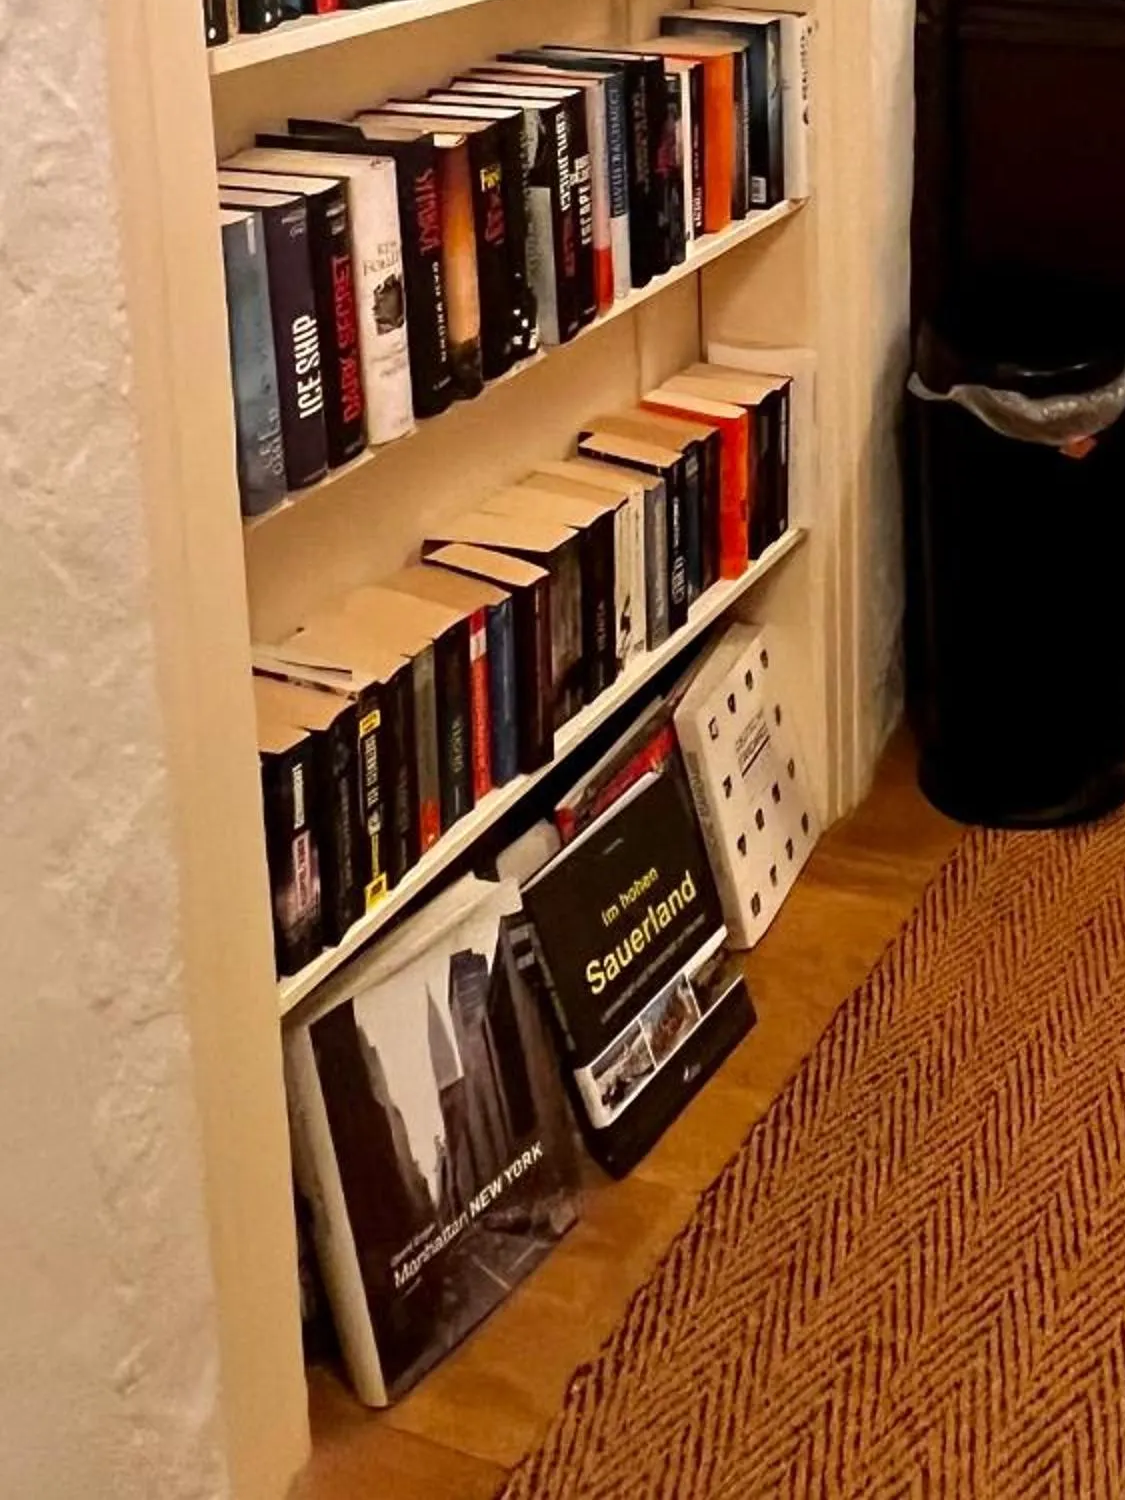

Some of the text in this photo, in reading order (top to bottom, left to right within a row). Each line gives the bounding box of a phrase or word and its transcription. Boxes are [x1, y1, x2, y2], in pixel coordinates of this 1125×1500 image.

[415, 167, 442, 256] SYMBOL
[331, 254, 355, 346] SECRET
[291, 313, 324, 419] ICE SHIP
[340, 355, 362, 423] DARK
[585, 870, 698, 995] Sauerland
[601, 867, 660, 927] Im hohen
[393, 1211, 471, 1289] Manhattan
[469, 1177, 505, 1219] NEW
[504, 1140, 545, 1185] YORK
